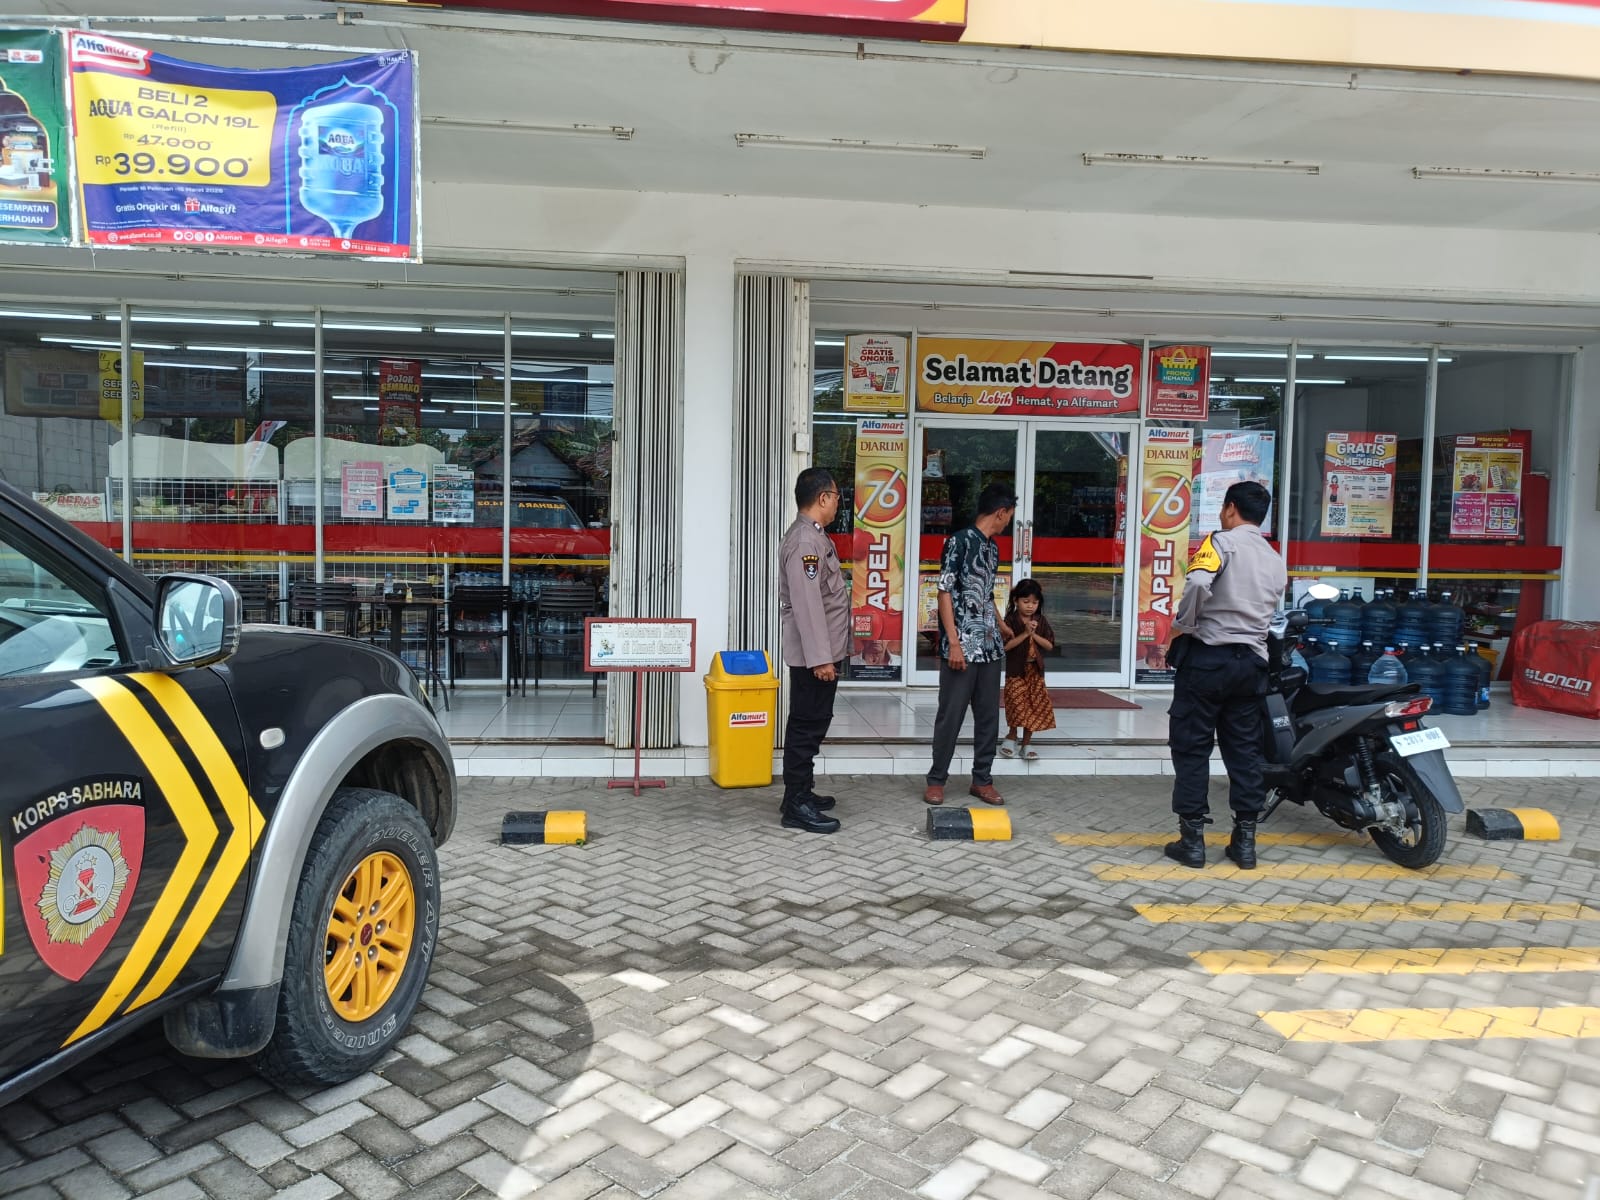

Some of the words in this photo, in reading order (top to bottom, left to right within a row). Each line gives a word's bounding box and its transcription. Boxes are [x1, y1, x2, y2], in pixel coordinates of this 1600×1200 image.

[76, 37, 139, 58] Alfamart
[137, 86, 189, 106] BELI
[193, 95, 209, 108] 2
[89, 98, 133, 119] AQUA
[137, 105, 219, 126] GALON
[222, 116, 260, 129] 19L
[123, 132, 135, 140] Rp
[136, 134, 213, 151] 47.000
[328, 133, 355, 145] AQUA
[95, 155, 111, 169] Rp
[115, 204, 136, 213] Gratis
[136, 202, 169, 212] Ongkir
[169, 203, 181, 212] di
[200, 204, 237, 215] Alfagift
[215, 234, 243, 242] Alfamart
[386, 374, 414, 383] POJOK
[924, 356, 1032, 387] Selamat
[1037, 361, 1131, 395] Datang
[103, 379, 139, 389] SERA
[103, 390, 139, 401] SEDH
[933, 392, 974, 407] Belanja
[976, 390, 1014, 408] Lebih
[1015, 395, 1053, 408] Hemat,
[1055, 400, 1070, 410] ya
[1070, 398, 1119, 410] Alfamart
[861, 420, 905, 430] Alfamart
[1148, 429, 1190, 438] Alfamart
[860, 441, 904, 452] DJARUM
[1336, 442, 1386, 456] GRATIS
[1146, 449, 1189, 460] DJARUM
[856, 468, 902, 521] 76
[1142, 476, 1187, 526] 76
[867, 534, 890, 612] APEL
[1151, 541, 1174, 617] APEL
[1534, 670, 1592, 692] LONCIN
[730, 712, 767, 721] Alfamart
[366, 826, 434, 888] DUELER
[421, 900, 435, 963] A/T
